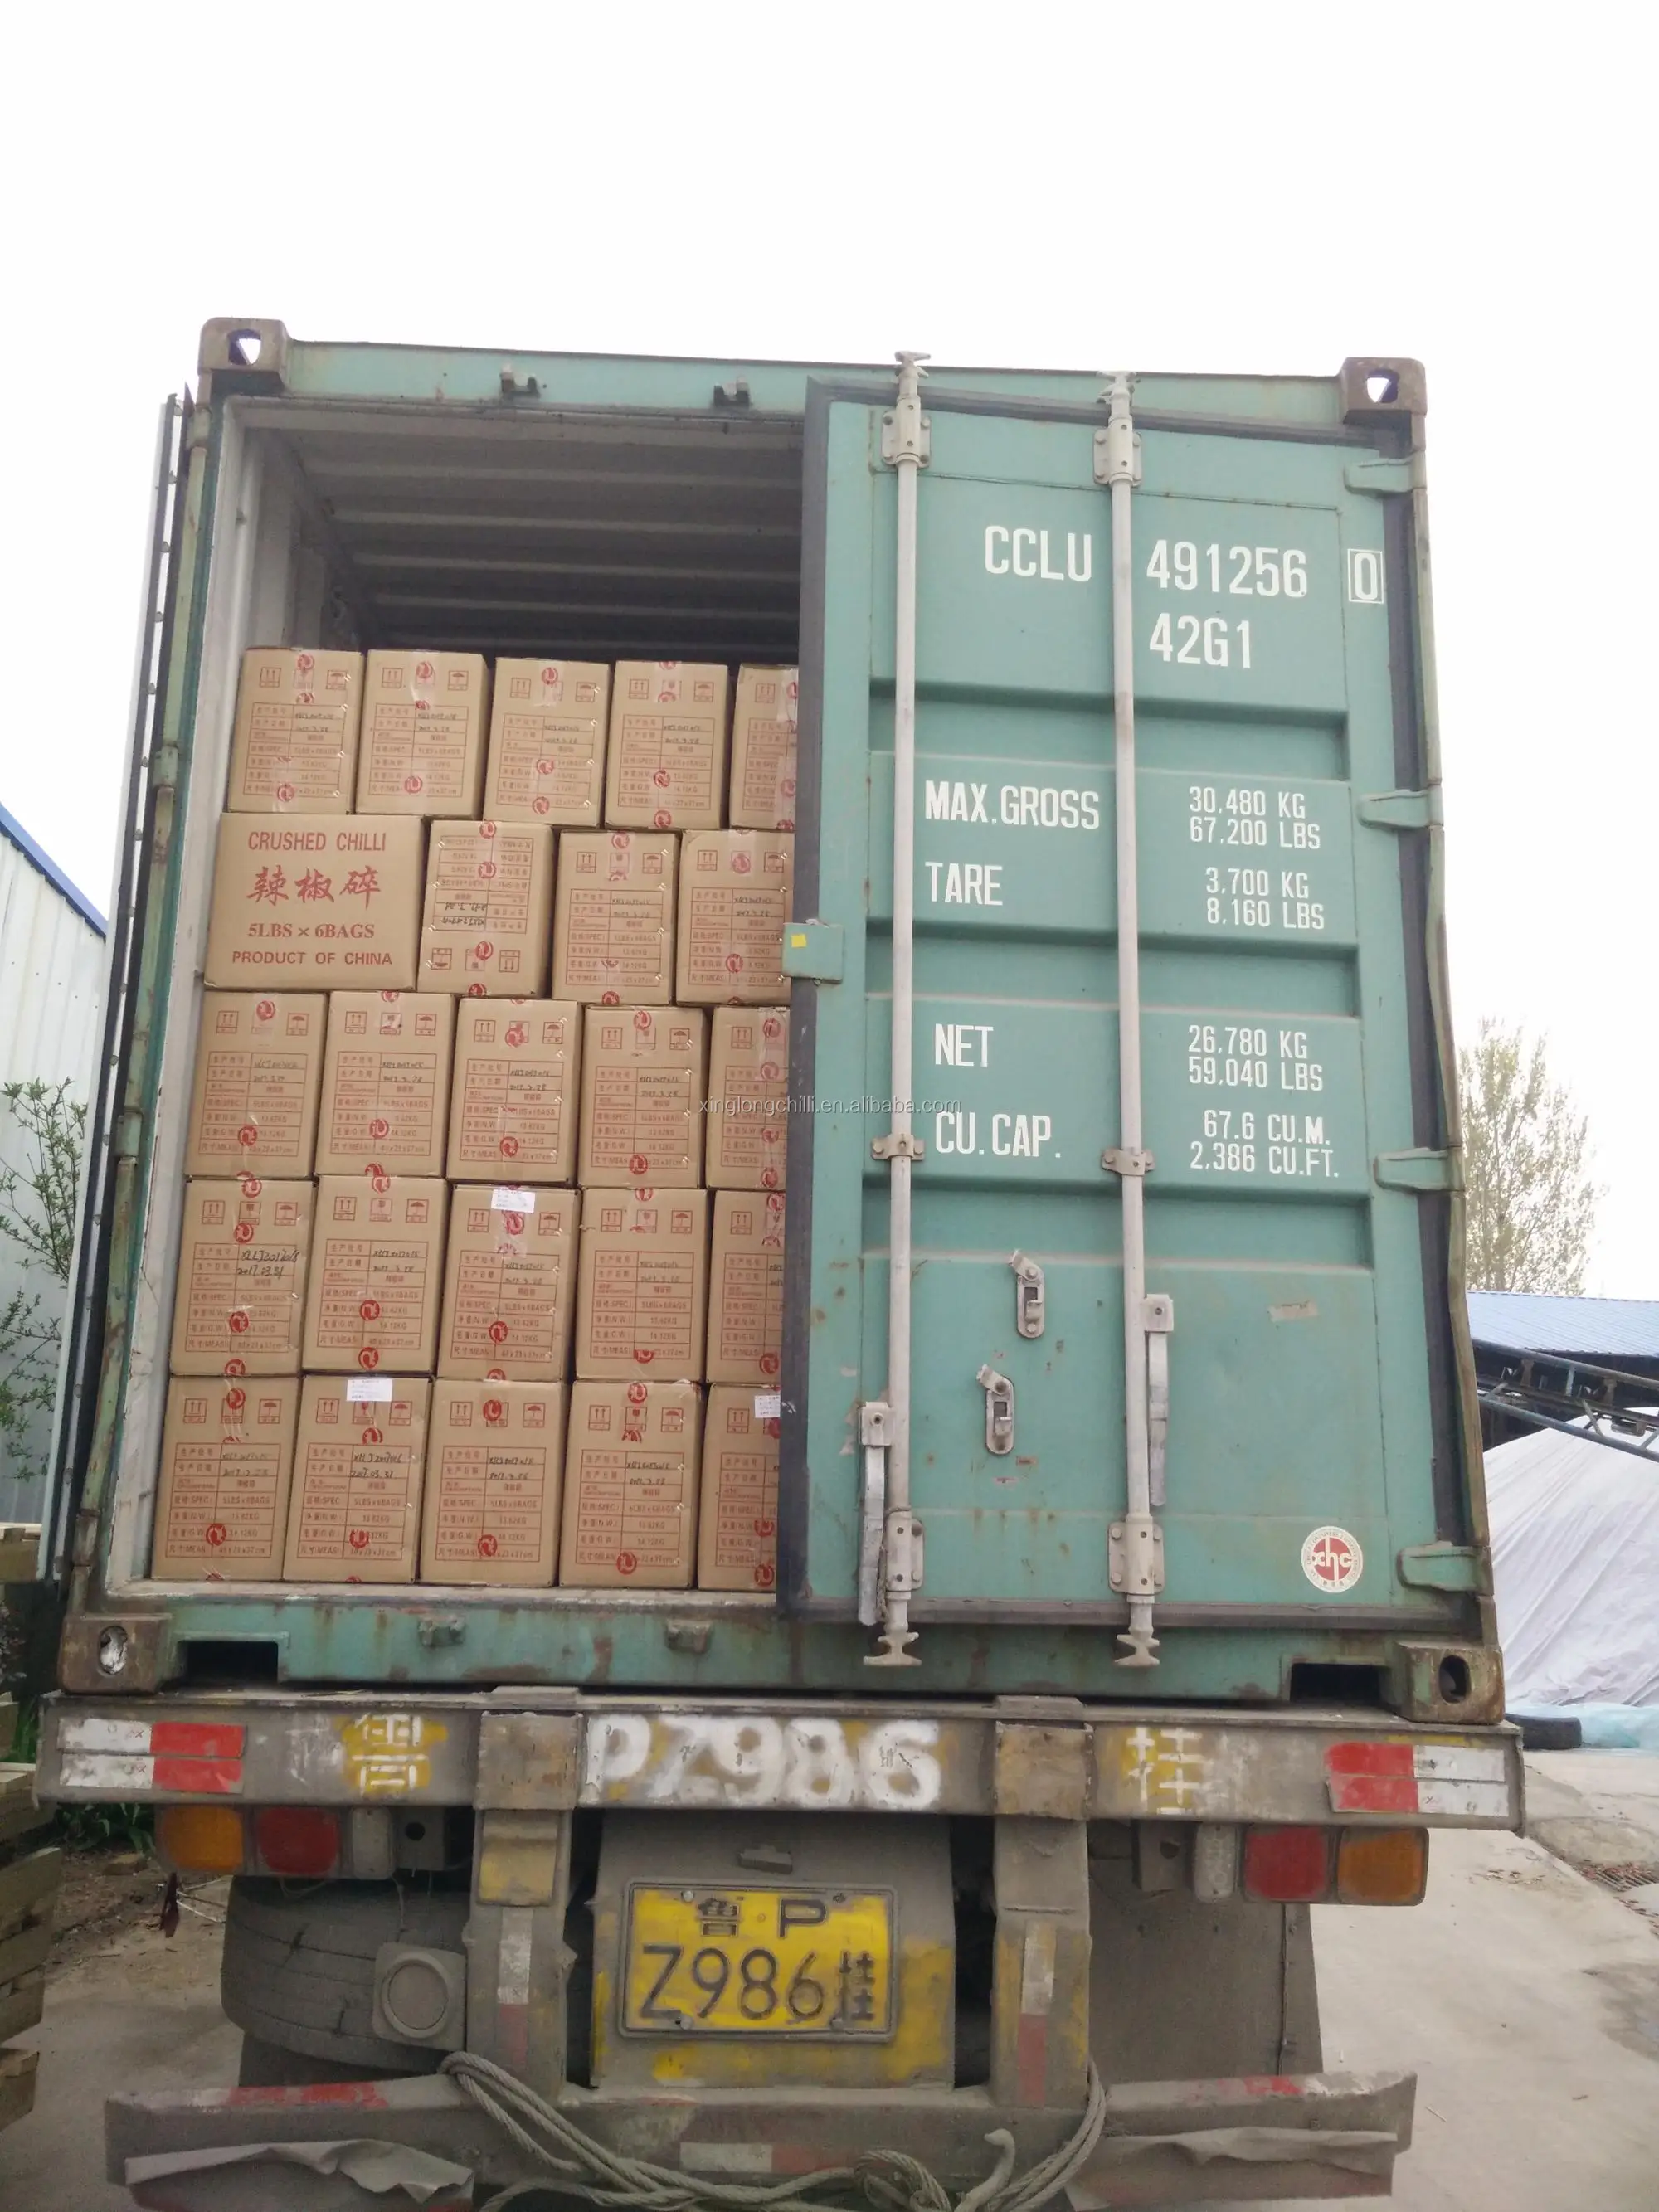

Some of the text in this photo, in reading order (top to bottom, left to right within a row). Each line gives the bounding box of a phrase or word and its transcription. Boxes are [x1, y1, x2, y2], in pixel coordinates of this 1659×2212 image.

[985, 525, 1092, 582] CCLU
[1146, 539, 1308, 598] 491256
[1149, 613, 1251, 668] 42G1
[925, 780, 1100, 830] MAX.GROSS
[1278, 791, 1306, 819] KG
[248, 831, 387, 852] CRUSHED CHILLI
[1279, 821, 1321, 849] LBS
[246, 864, 381, 911] 辣椒碎
[925, 861, 1309, 906] TARE 3,700 KG
[248, 923, 293, 938] 5LBS
[314, 923, 375, 939] 6BAGS
[1207, 897, 1325, 930] 8,160 LBS
[232, 950, 392, 965] PRODUCT OF CHINA
[935, 1023, 1308, 1067] NET 26,780 KG
[1189, 1056, 1323, 1091] 59,040 LBS
[1204, 1110, 1255, 1140] 67.6
[1267, 1114, 1331, 1145] CU.M.
[1190, 1140, 1340, 1178] 2,386 CU.FT.
